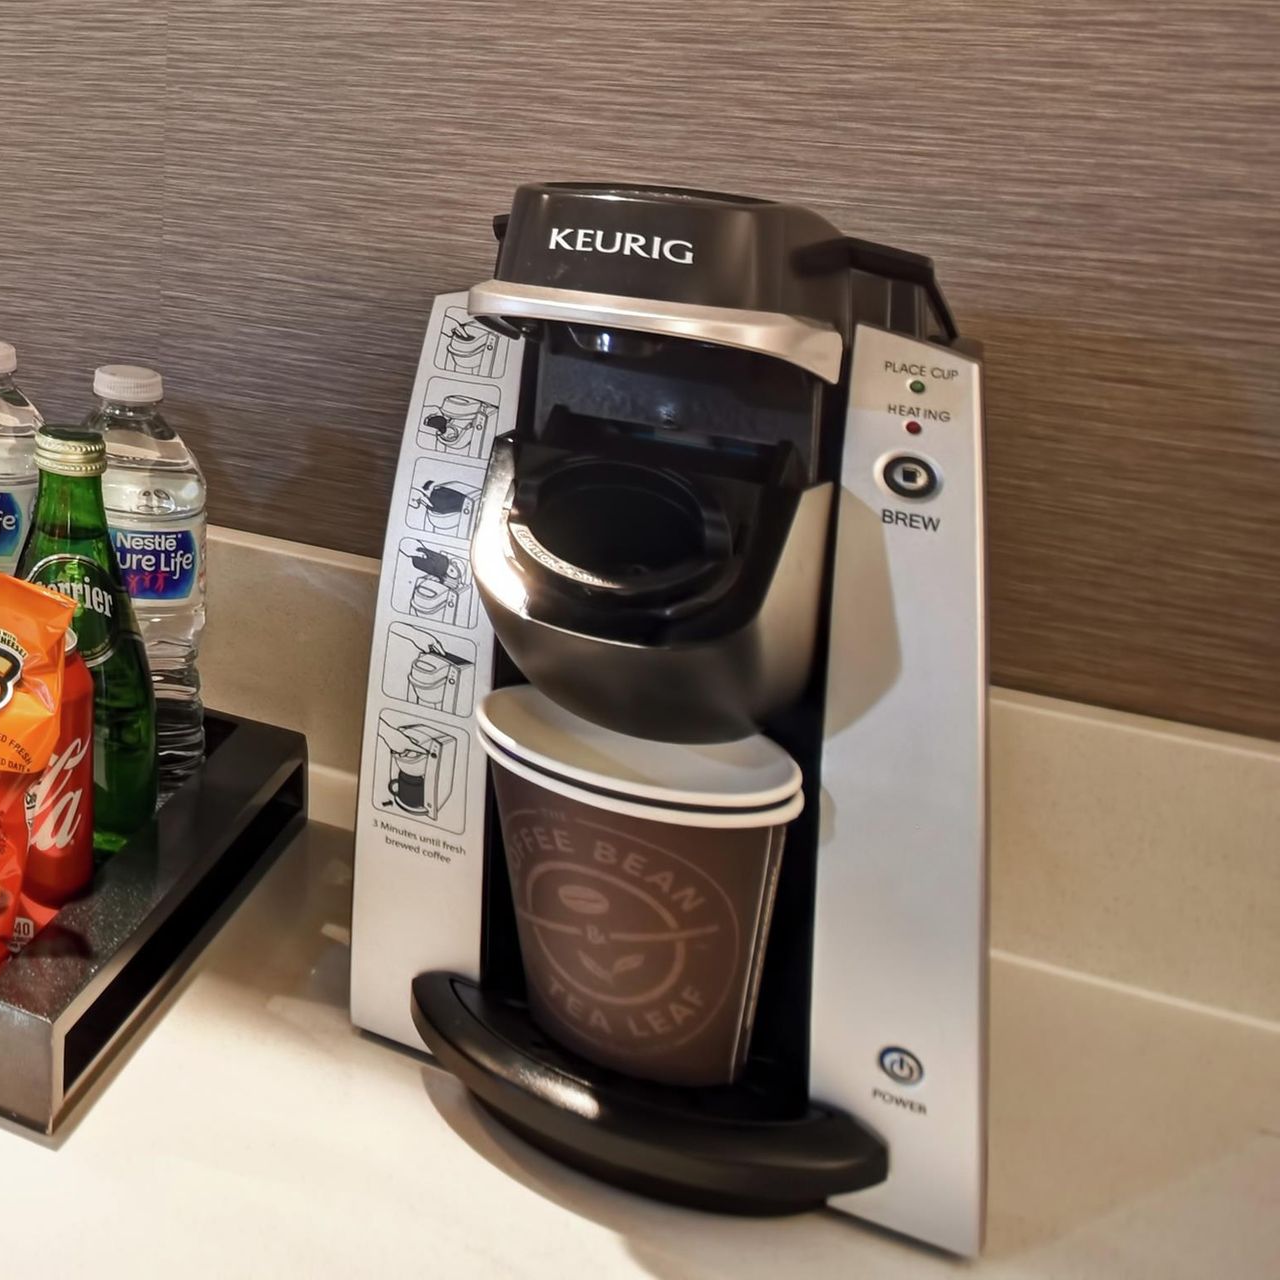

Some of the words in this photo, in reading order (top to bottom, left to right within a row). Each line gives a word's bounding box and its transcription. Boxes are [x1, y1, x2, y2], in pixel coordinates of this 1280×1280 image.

[549, 228, 694, 264] KEURIG
[884, 361, 926, 377] PLACE
[930, 368, 959, 380] CUP
[888, 404, 951, 422] HEATING
[882, 509, 940, 532] BREW
[116, 551, 156, 572] ure
[160, 550, 193, 580] Life
[8, 739, 32, 765] FRESH
[8, 760, 26, 773] DATE
[372, 818, 379, 827] 3
[380, 821, 417, 840] Minutes
[419, 835, 441, 847] until
[442, 841, 466, 856] fresh
[385, 836, 420, 854] brewed
[422, 849, 451, 864] coffee
[508, 827, 576, 870] OFFEE
[593, 841, 706, 913] BEAN
[548, 977, 613, 1034] TEA
[627, 985, 705, 1038] LEAF
[872, 1087, 927, 1115] POWER
